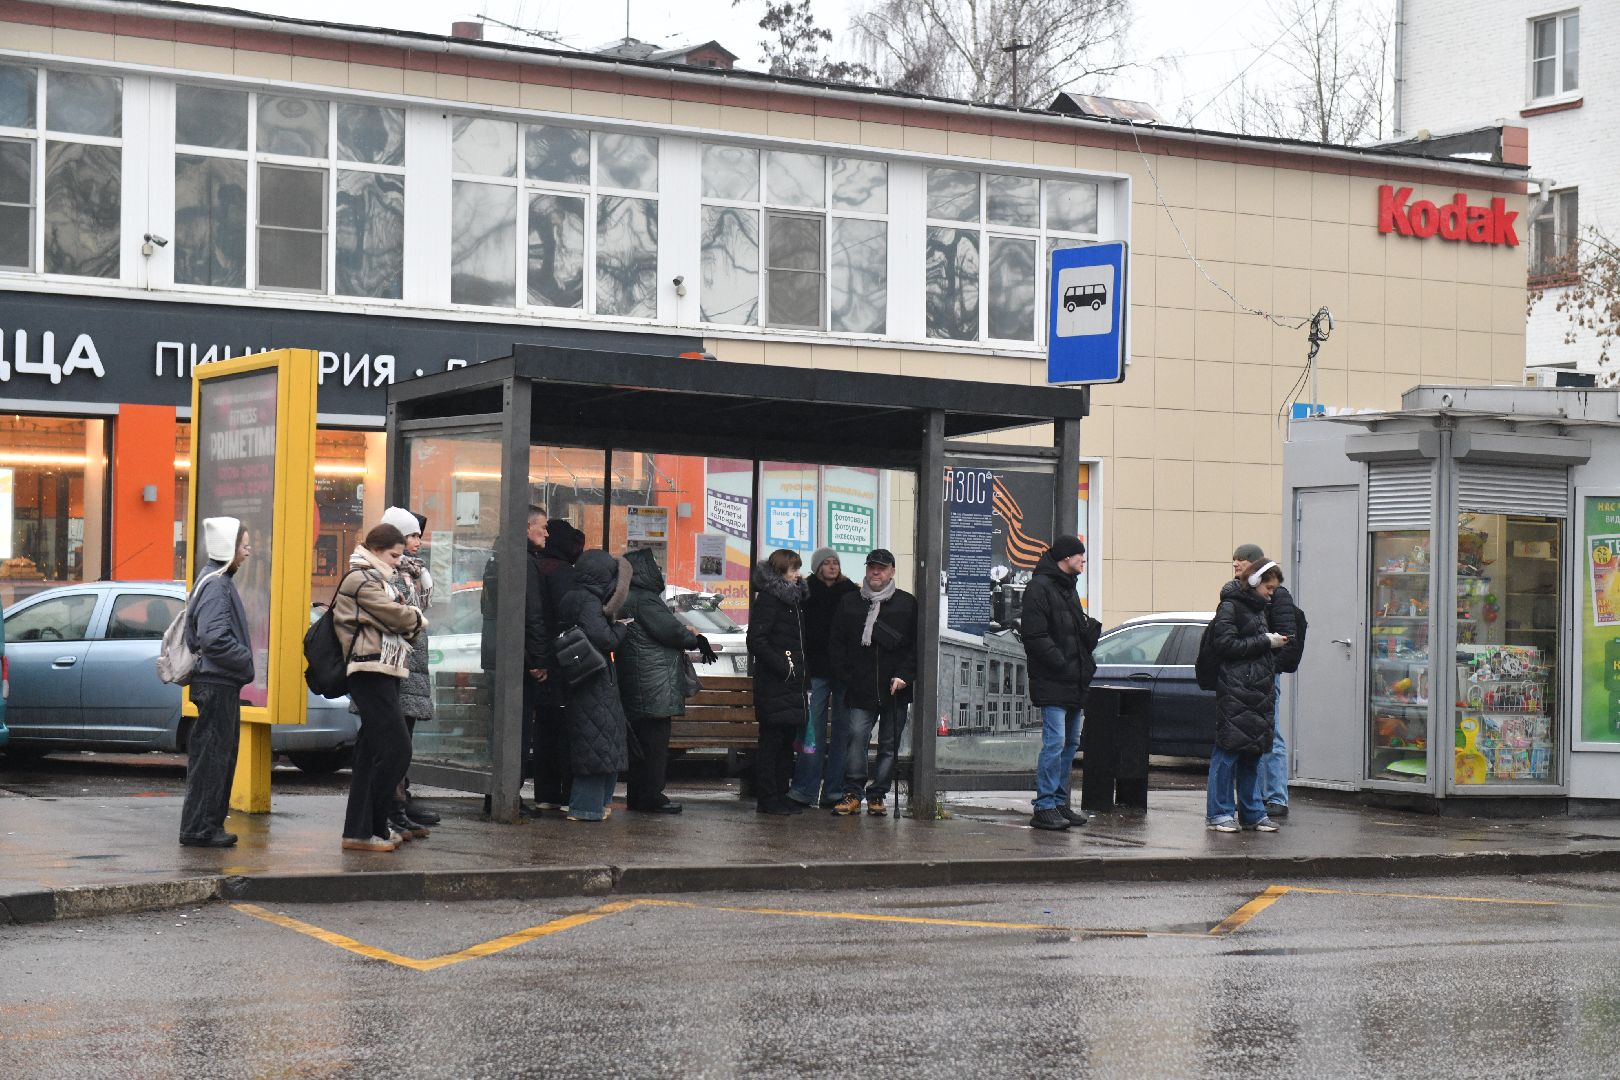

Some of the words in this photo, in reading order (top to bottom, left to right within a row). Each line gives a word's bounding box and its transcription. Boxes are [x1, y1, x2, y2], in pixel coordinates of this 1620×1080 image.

[1378, 185, 1520, 247] Kodak
[713, 505, 742, 520] буклеты
[785, 518, 796, 539] 1
